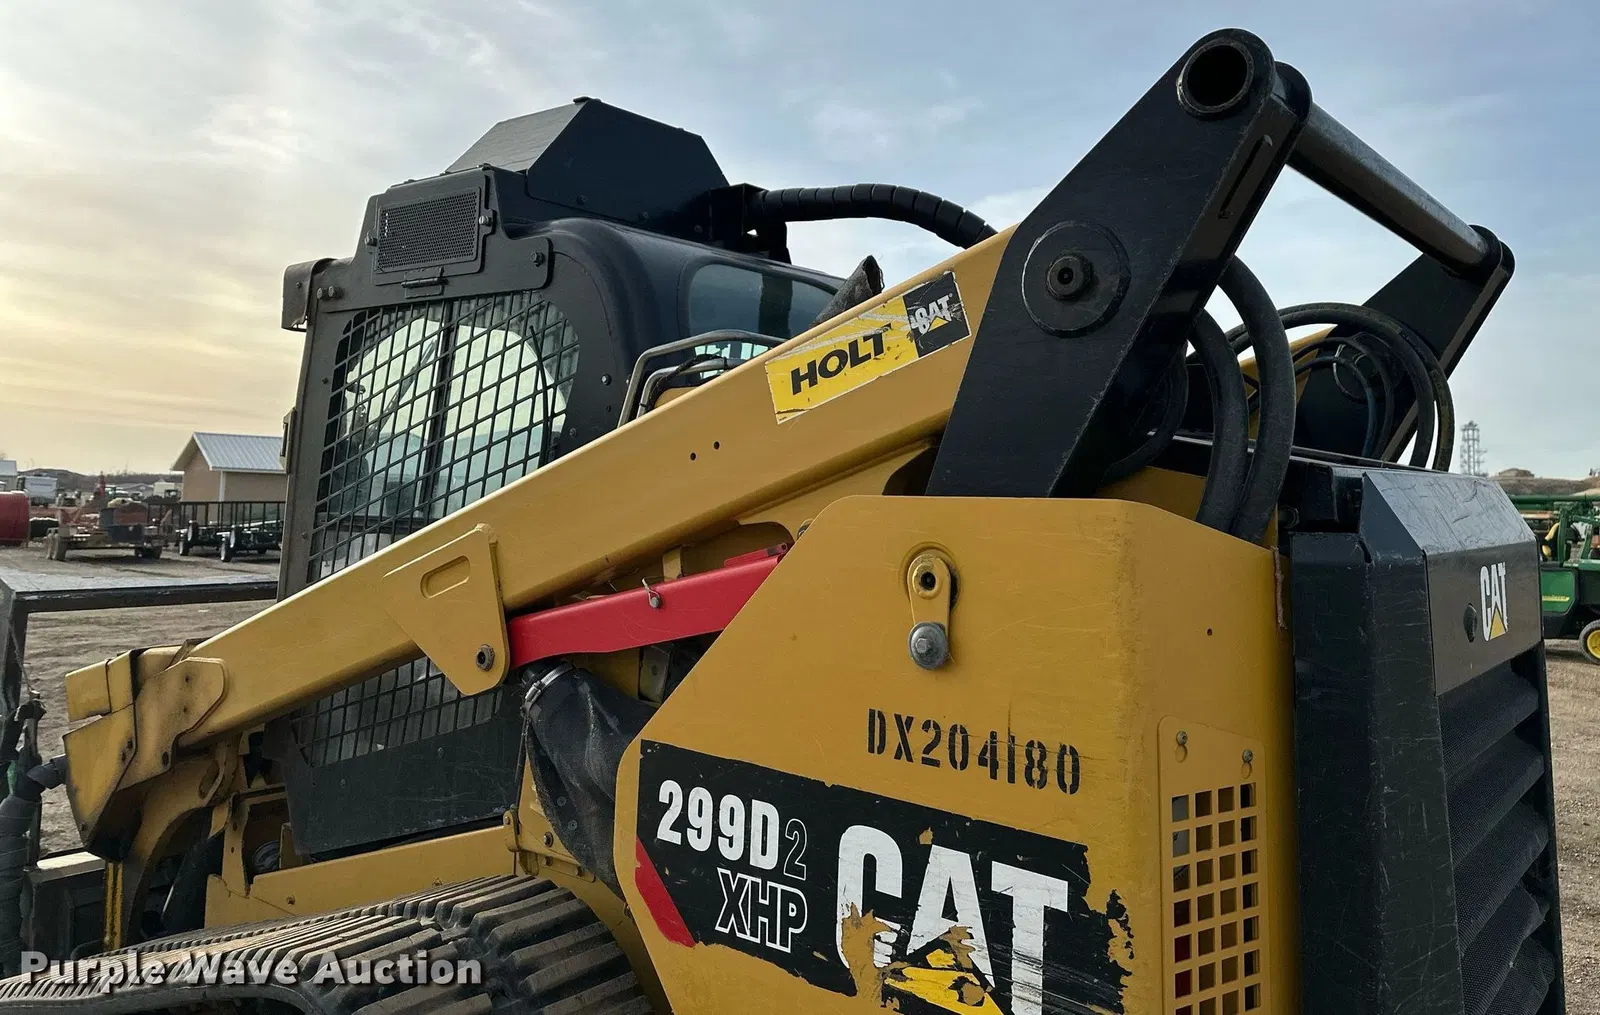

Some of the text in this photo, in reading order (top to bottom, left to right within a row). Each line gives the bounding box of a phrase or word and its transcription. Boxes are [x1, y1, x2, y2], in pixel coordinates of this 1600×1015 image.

[790, 322, 892, 395] HOLT
[1480, 562, 1508, 642] CAT
[867, 708, 1080, 795] DX204180
[714, 866, 808, 953] XHP
[836, 824, 1068, 1015] CAT
